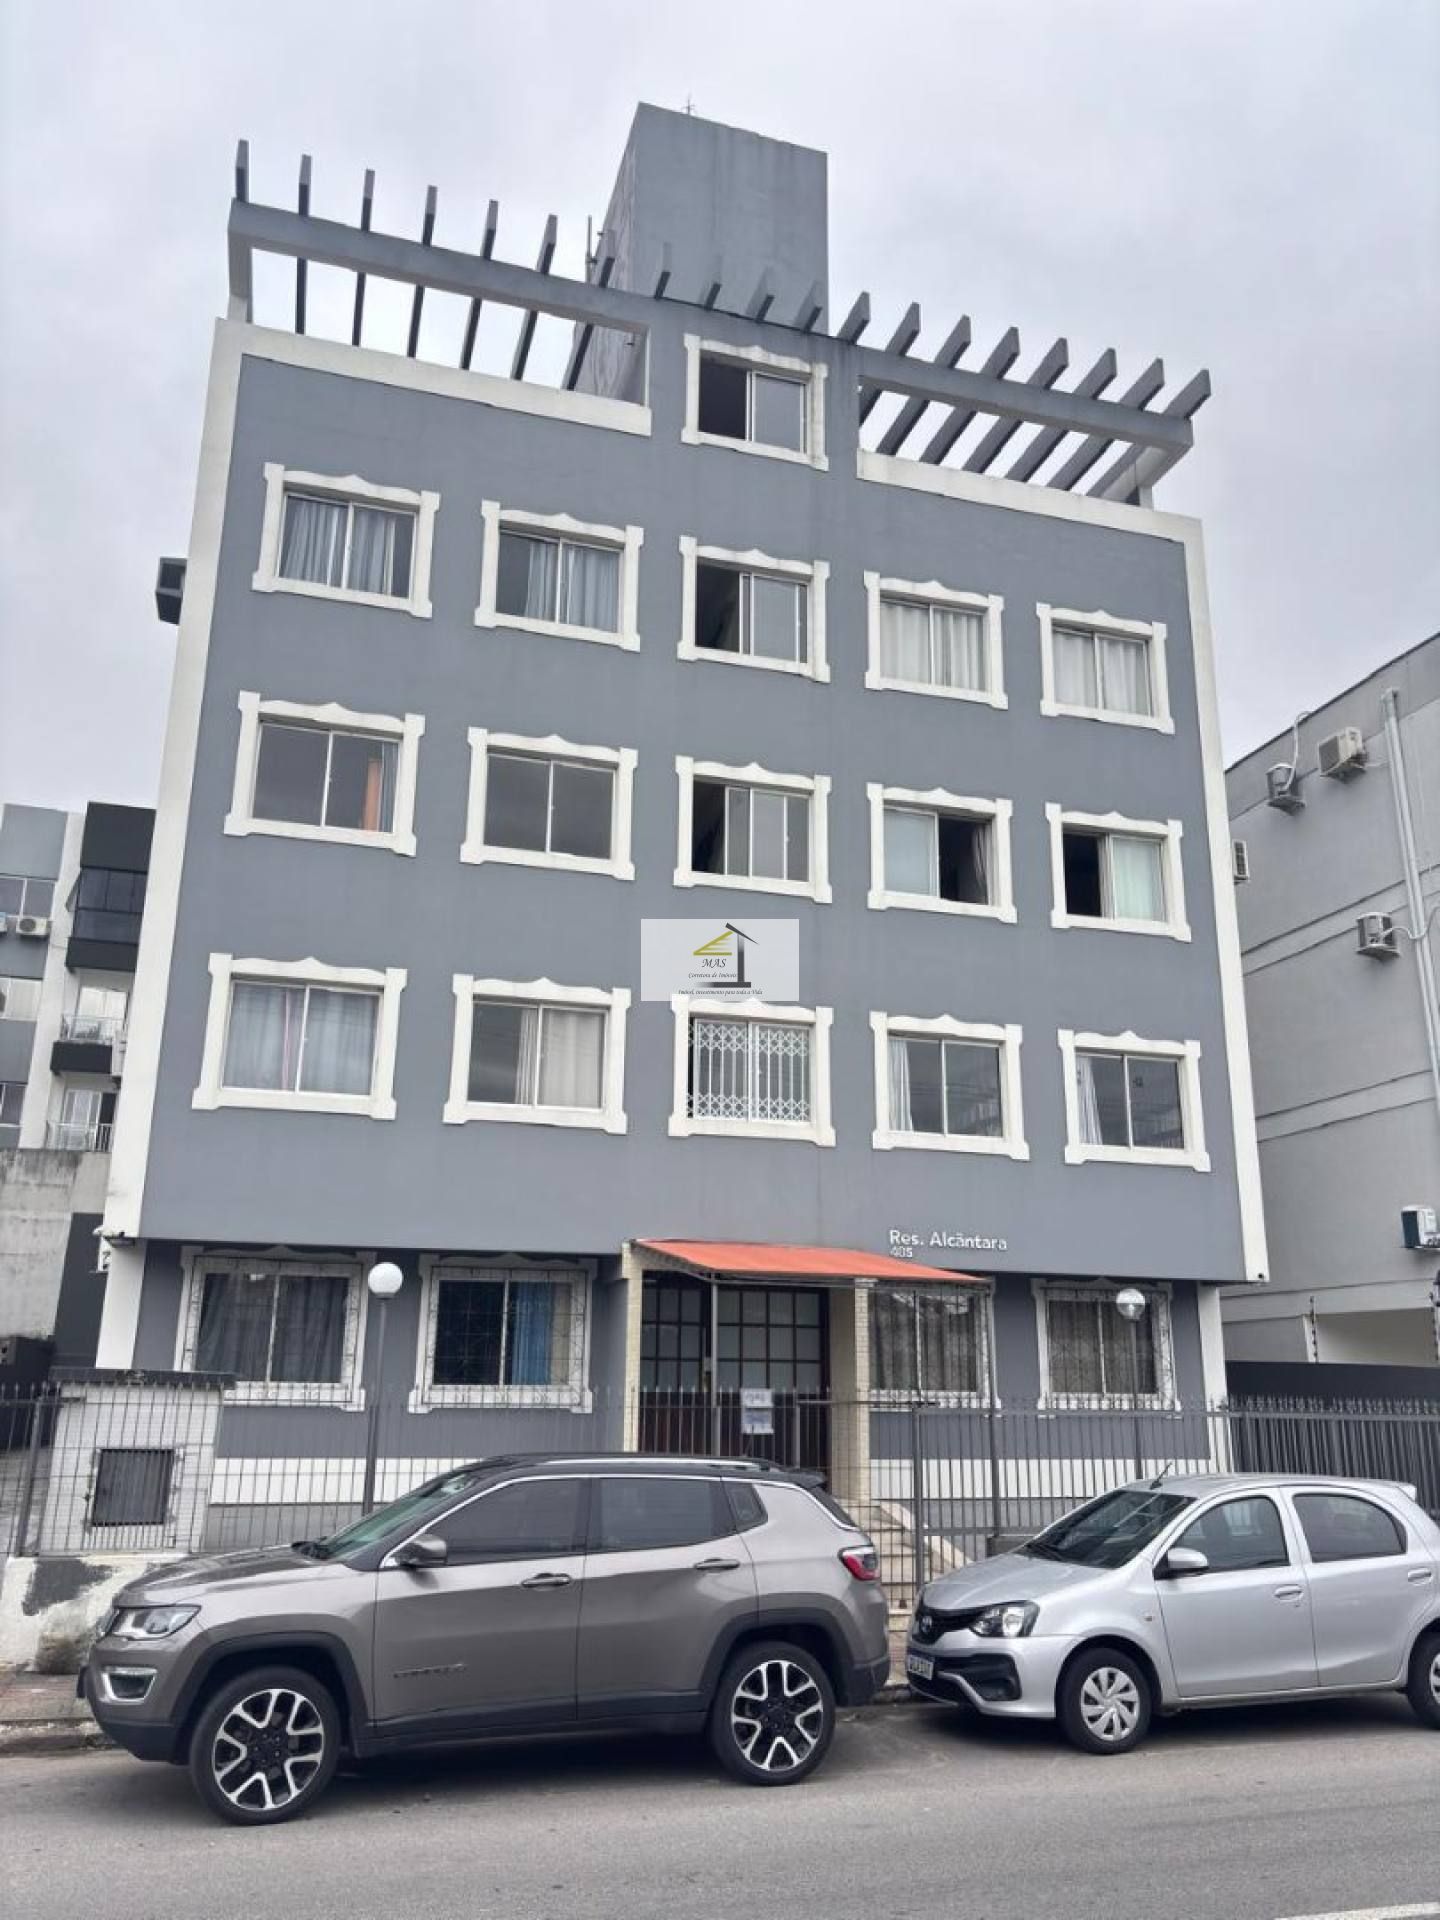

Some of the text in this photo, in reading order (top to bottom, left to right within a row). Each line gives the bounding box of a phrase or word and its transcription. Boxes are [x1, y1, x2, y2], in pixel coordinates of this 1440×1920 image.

[889, 1229, 1008, 1251] Res. Alcântara
[890, 1246, 913, 1258] 405
